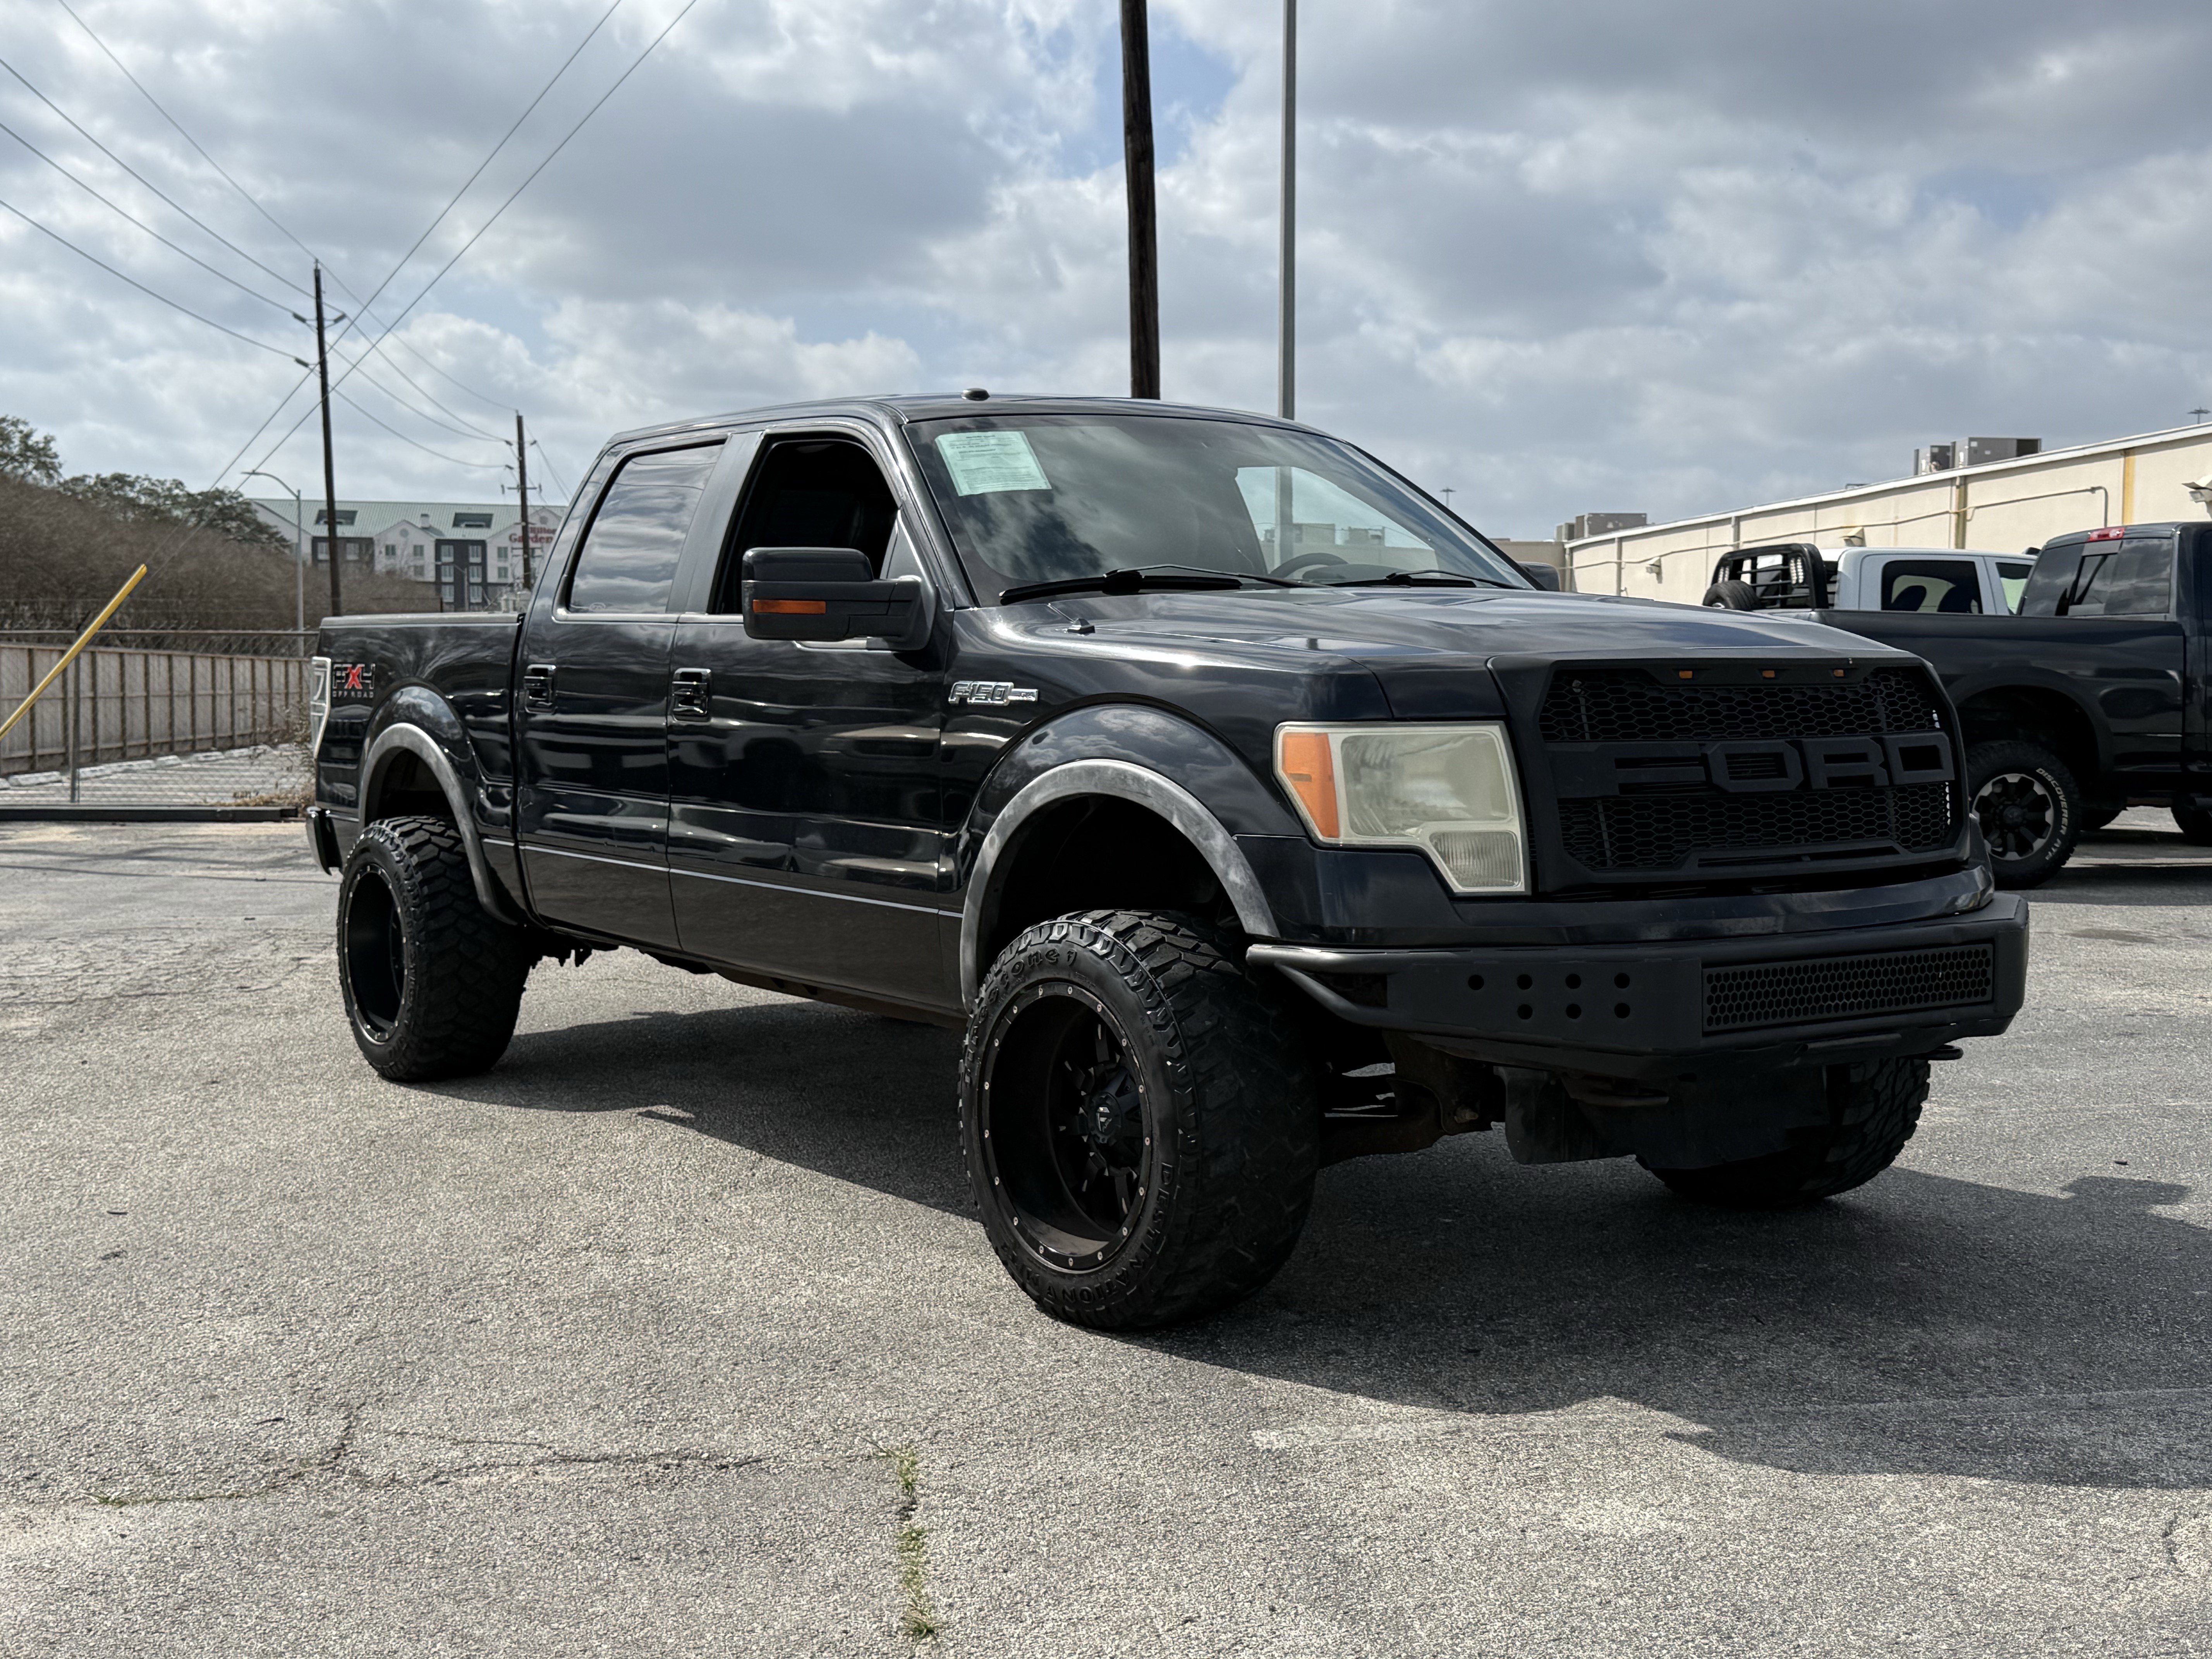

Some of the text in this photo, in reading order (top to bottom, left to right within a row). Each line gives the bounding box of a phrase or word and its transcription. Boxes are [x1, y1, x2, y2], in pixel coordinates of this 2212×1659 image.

[508, 533, 554, 543] Gaden
[1588, 731, 1955, 798] FORD
[2036, 767, 2068, 835] DISCOVERER
